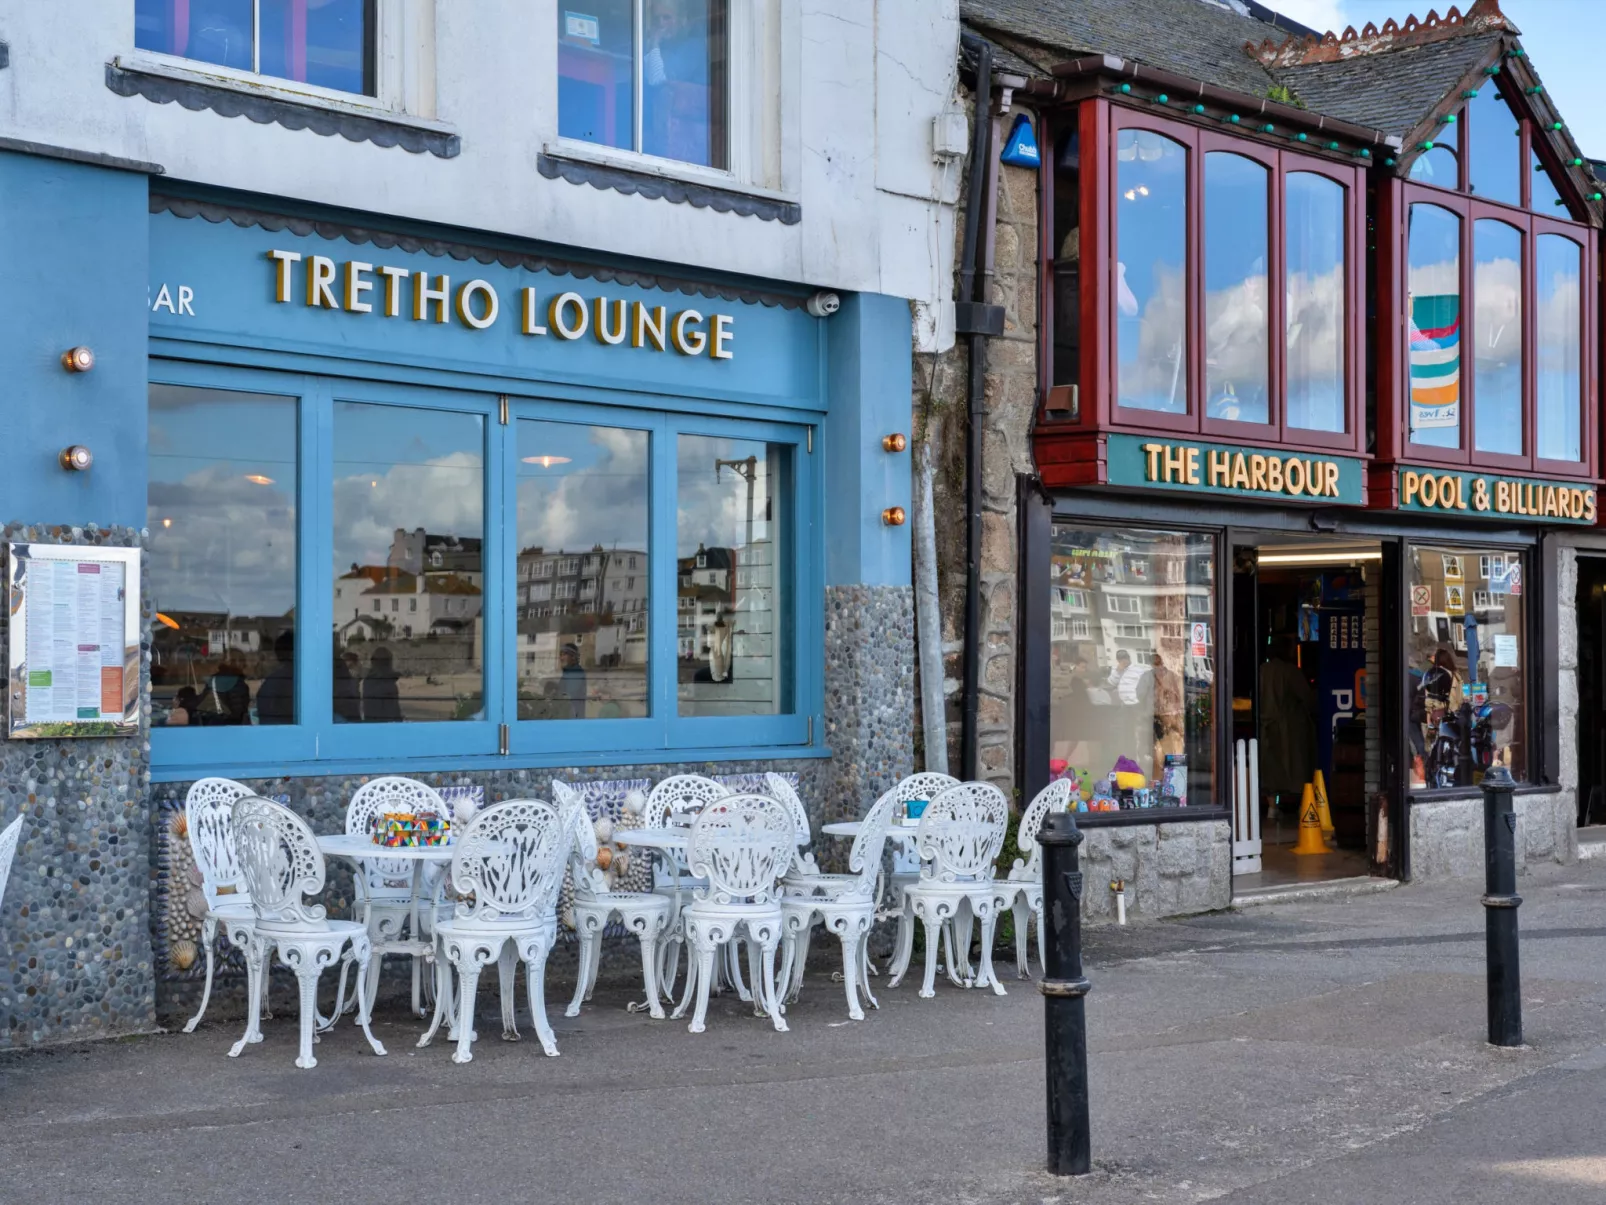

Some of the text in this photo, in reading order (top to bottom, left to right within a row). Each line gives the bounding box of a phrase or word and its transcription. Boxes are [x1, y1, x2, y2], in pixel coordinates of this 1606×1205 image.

[148, 283, 195, 316] AR
[266, 249, 734, 360] TRETHO LOUNGE
[1143, 444, 1339, 497] THE HARBOUR
[1402, 471, 1595, 520] POOL & BILLIARDS
